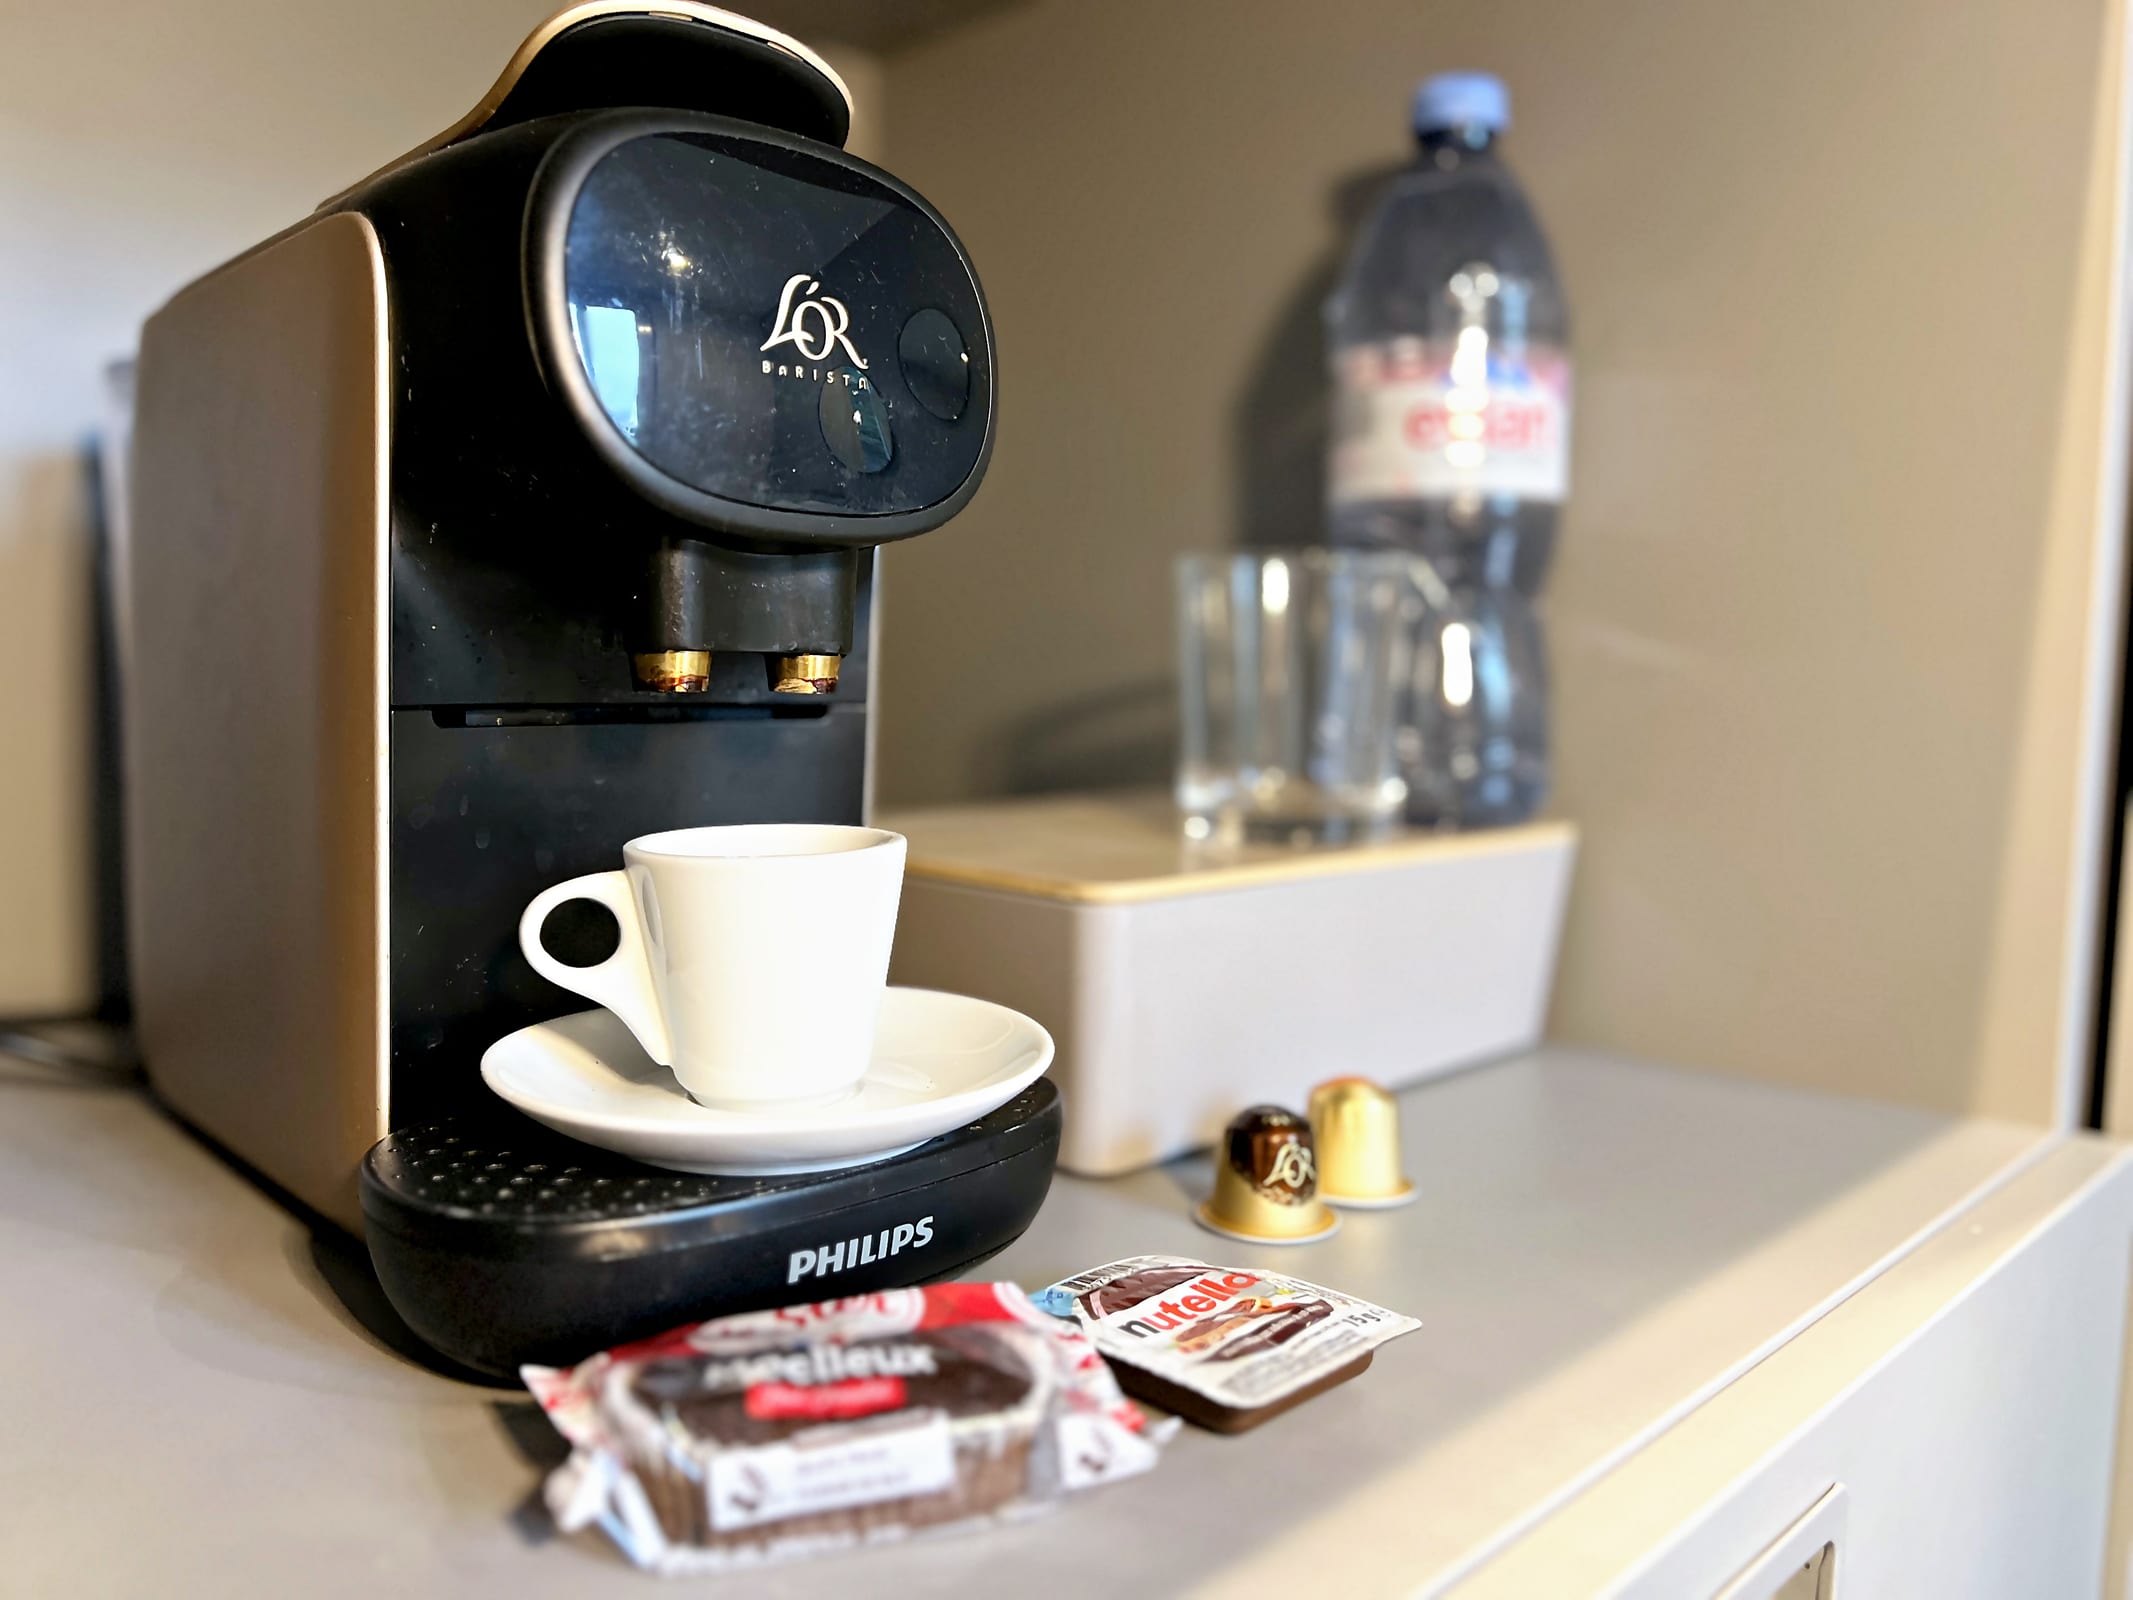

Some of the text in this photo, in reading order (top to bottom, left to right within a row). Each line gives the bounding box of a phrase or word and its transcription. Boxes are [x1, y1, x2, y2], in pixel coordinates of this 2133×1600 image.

[760, 274, 869, 369] L'OR
[761, 360, 867, 390] BARISTA
[1403, 408, 1553, 452] eian
[788, 1216, 934, 1284] PHILIPS
[1118, 1272, 1258, 1337] nutella
